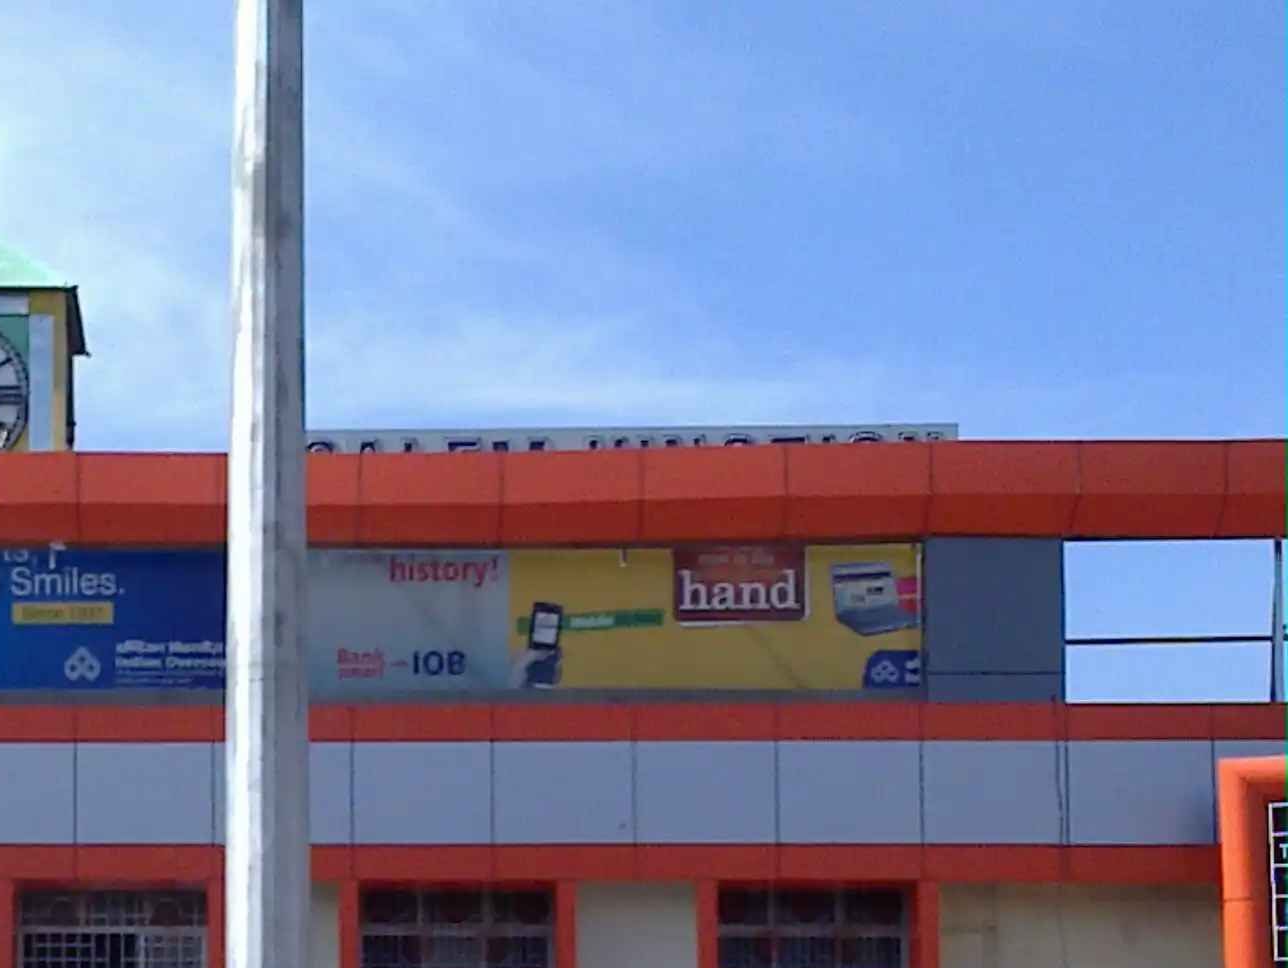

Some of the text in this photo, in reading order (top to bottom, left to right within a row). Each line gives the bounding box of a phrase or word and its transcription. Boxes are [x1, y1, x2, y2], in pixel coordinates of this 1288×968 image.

[11, 566, 126, 596] Smiles.
[389, 556, 500, 587] history!
[678, 569, 800, 611] hand
[412, 650, 466, 676] IOB
